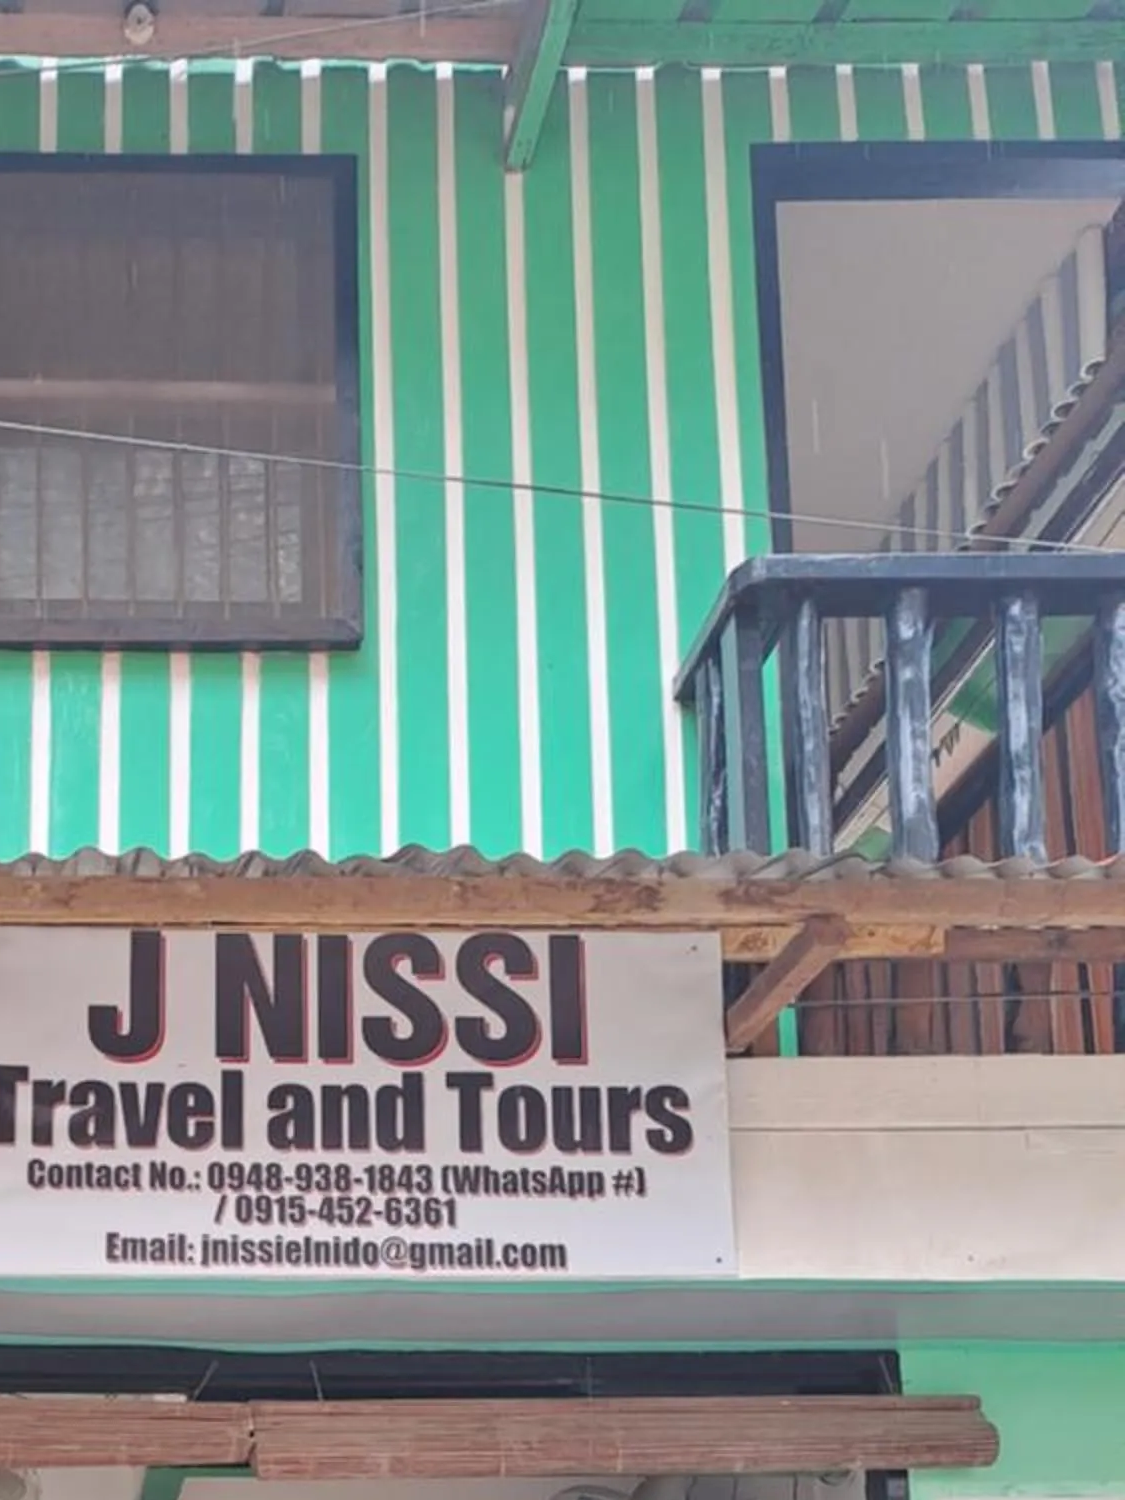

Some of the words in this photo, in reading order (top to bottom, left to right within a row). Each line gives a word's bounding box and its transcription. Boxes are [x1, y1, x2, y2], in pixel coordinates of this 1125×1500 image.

[88, 930, 166, 1063] J
[215, 932, 589, 1065] NISSI
[266, 1071, 426, 1155] and
[446, 1071, 695, 1157] Tours
[27, 1158, 141, 1191] Contact
[149, 1161, 202, 1192] No.:
[207, 1162, 433, 1195] 0948-938-1843
[441, 1164, 606, 1198] (WhatsApp
[612, 1166, 647, 1197] #)
[214, 1195, 227, 1225] /
[235, 1195, 458, 1228] 0915-452-6361
[106, 1232, 195, 1264] Email:
[201, 1233, 568, 1270] jnissielnido@gmail.com
